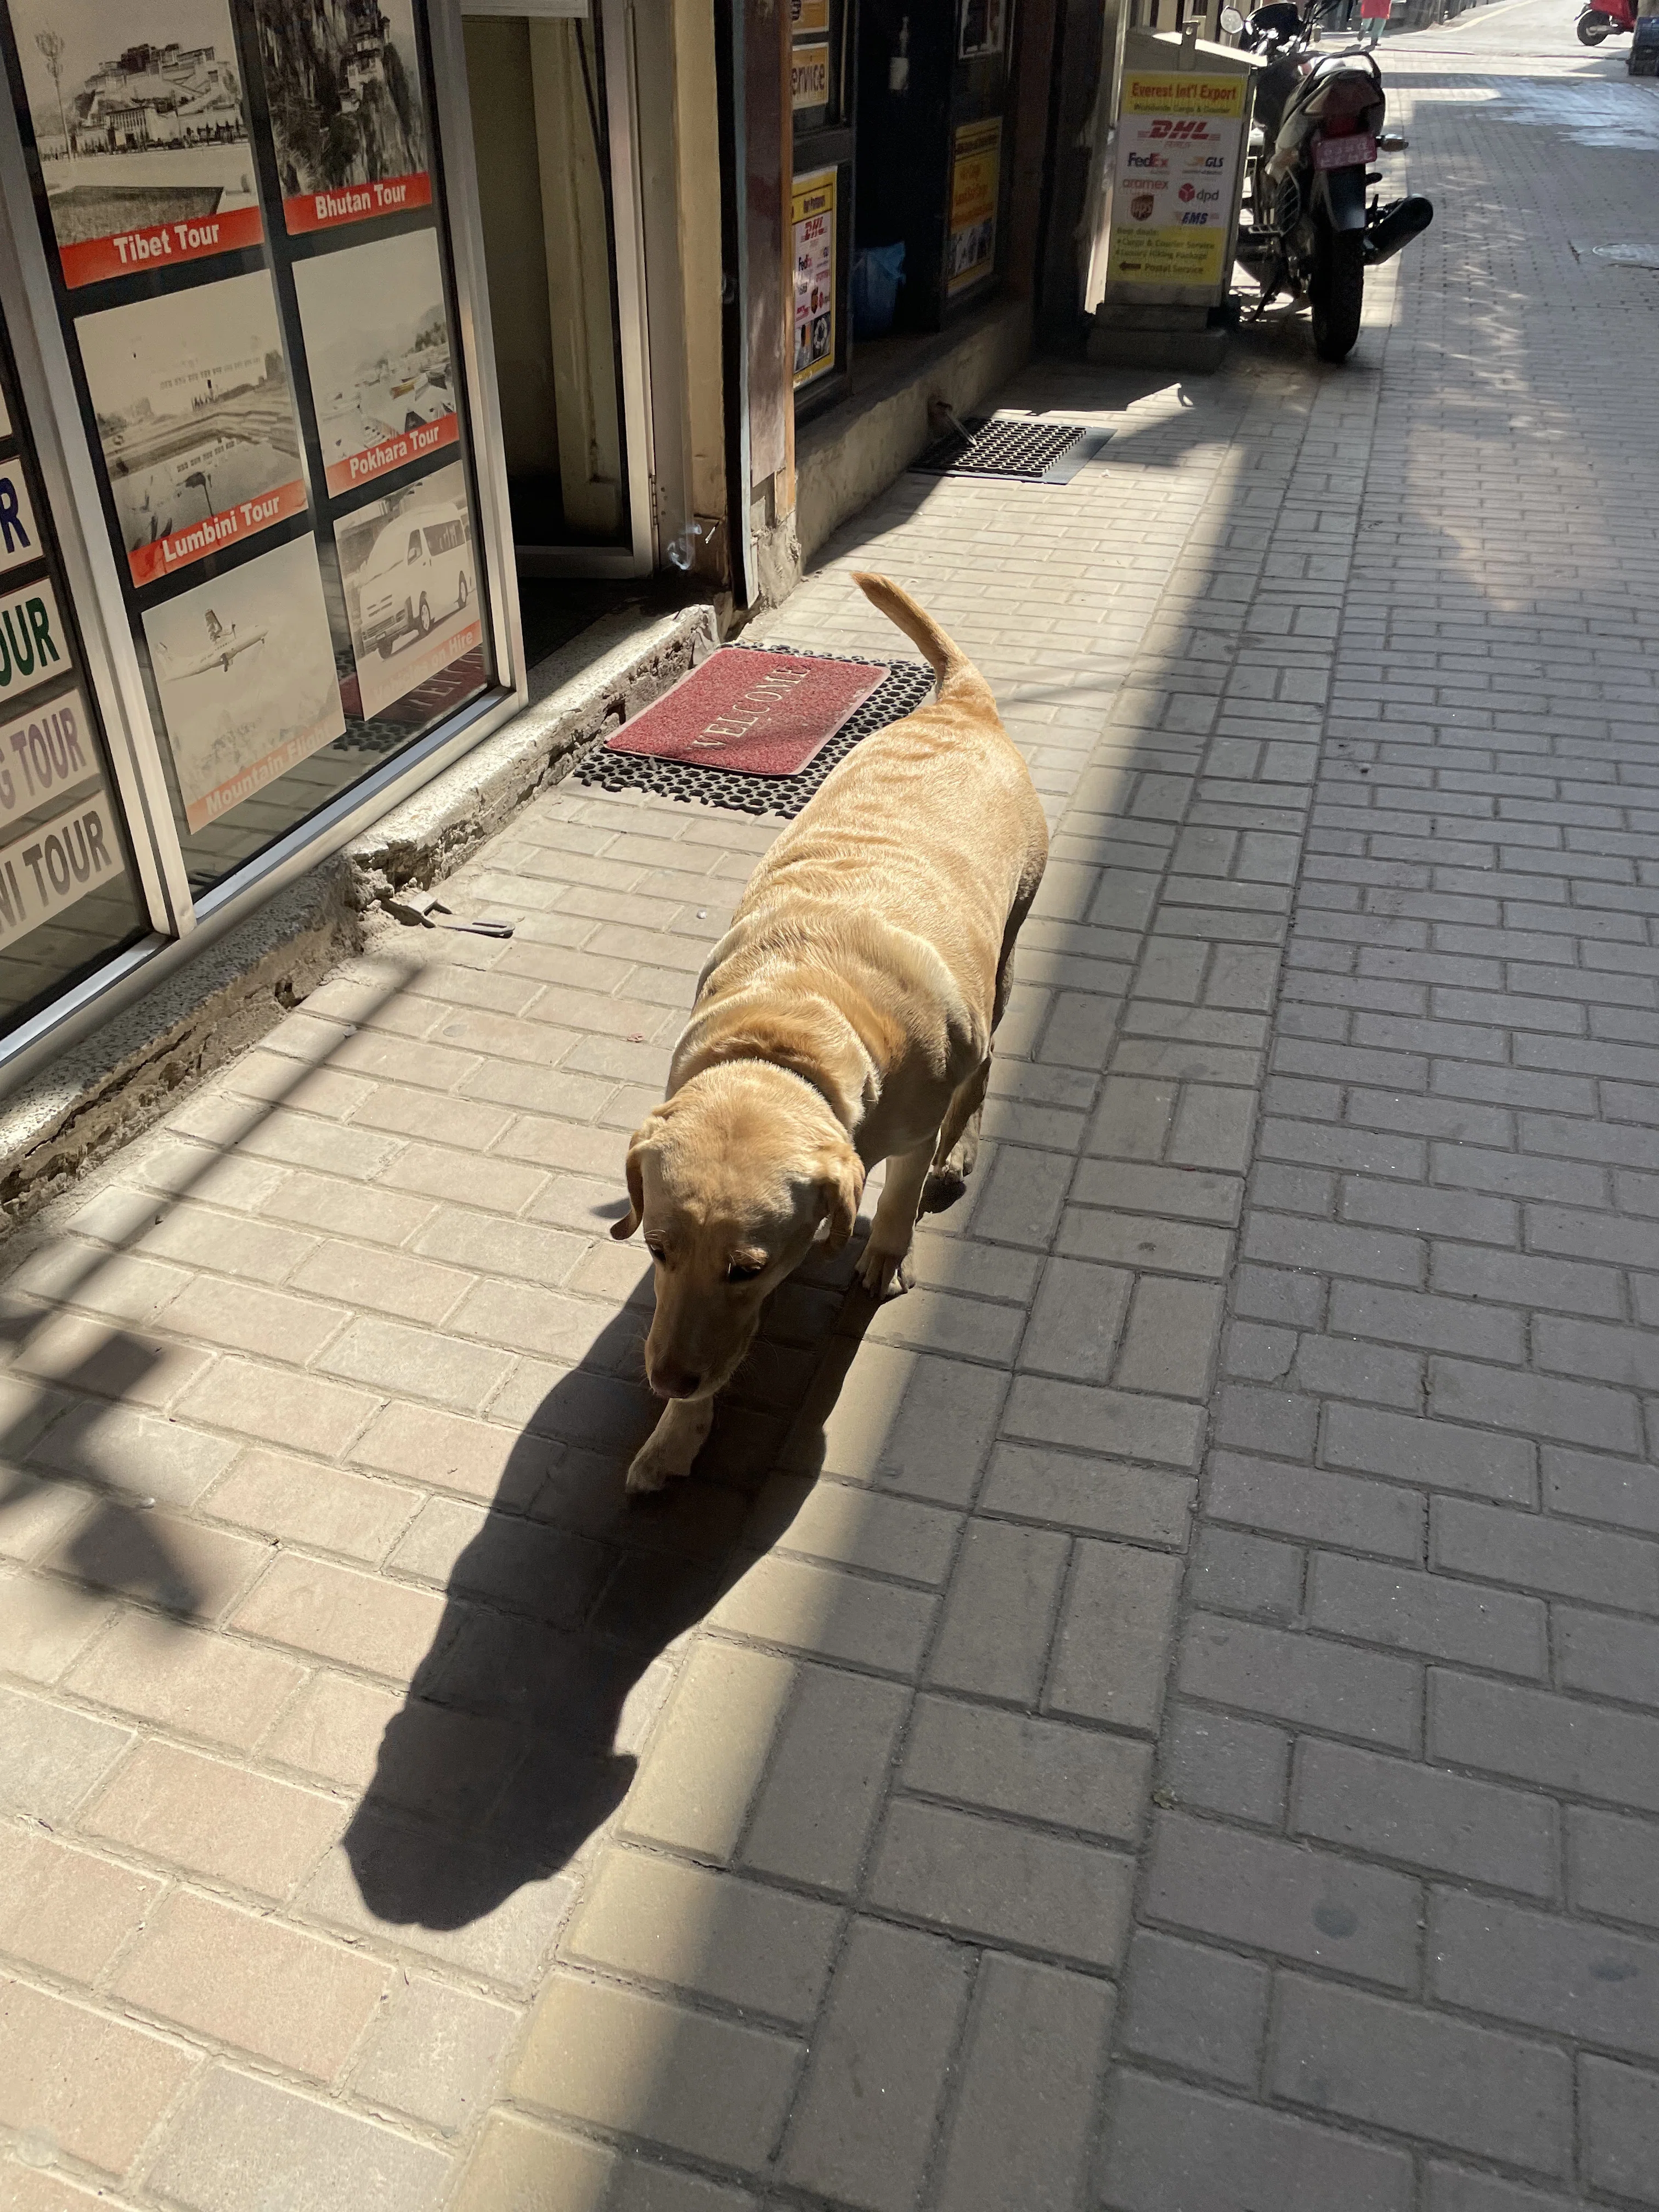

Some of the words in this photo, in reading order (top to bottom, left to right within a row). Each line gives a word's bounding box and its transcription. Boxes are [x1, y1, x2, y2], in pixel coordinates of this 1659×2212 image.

[1131, 82, 1172, 98] Everest
[1200, 84, 1236, 101] Export
[1149, 120, 1210, 139] DHL
[1127, 152, 1169, 167] FedEx
[1205, 156, 1224, 167] GLS
[315, 192, 371, 219] Bhutan
[374, 184, 406, 206] Tour
[1124, 178, 1169, 190] aramex
[1197, 189, 1219, 202] dpd
[1181, 212, 1208, 225] EMS
[114, 229, 172, 263] Tibet
[174, 224, 219, 250] Tour
[349, 441, 408, 479] Pokhara
[409, 426, 439, 450] Tour
[162, 510, 237, 562] Lumbini
[240, 497, 279, 526] Tour
[431, 648, 447, 667] on
[449, 631, 473, 656] Hire
[686, 663, 811, 751] WELCOME
[9, 707, 87, 797] TOUR
[205, 756, 284, 816] Mountain
[22, 810, 112, 907] TOUR
